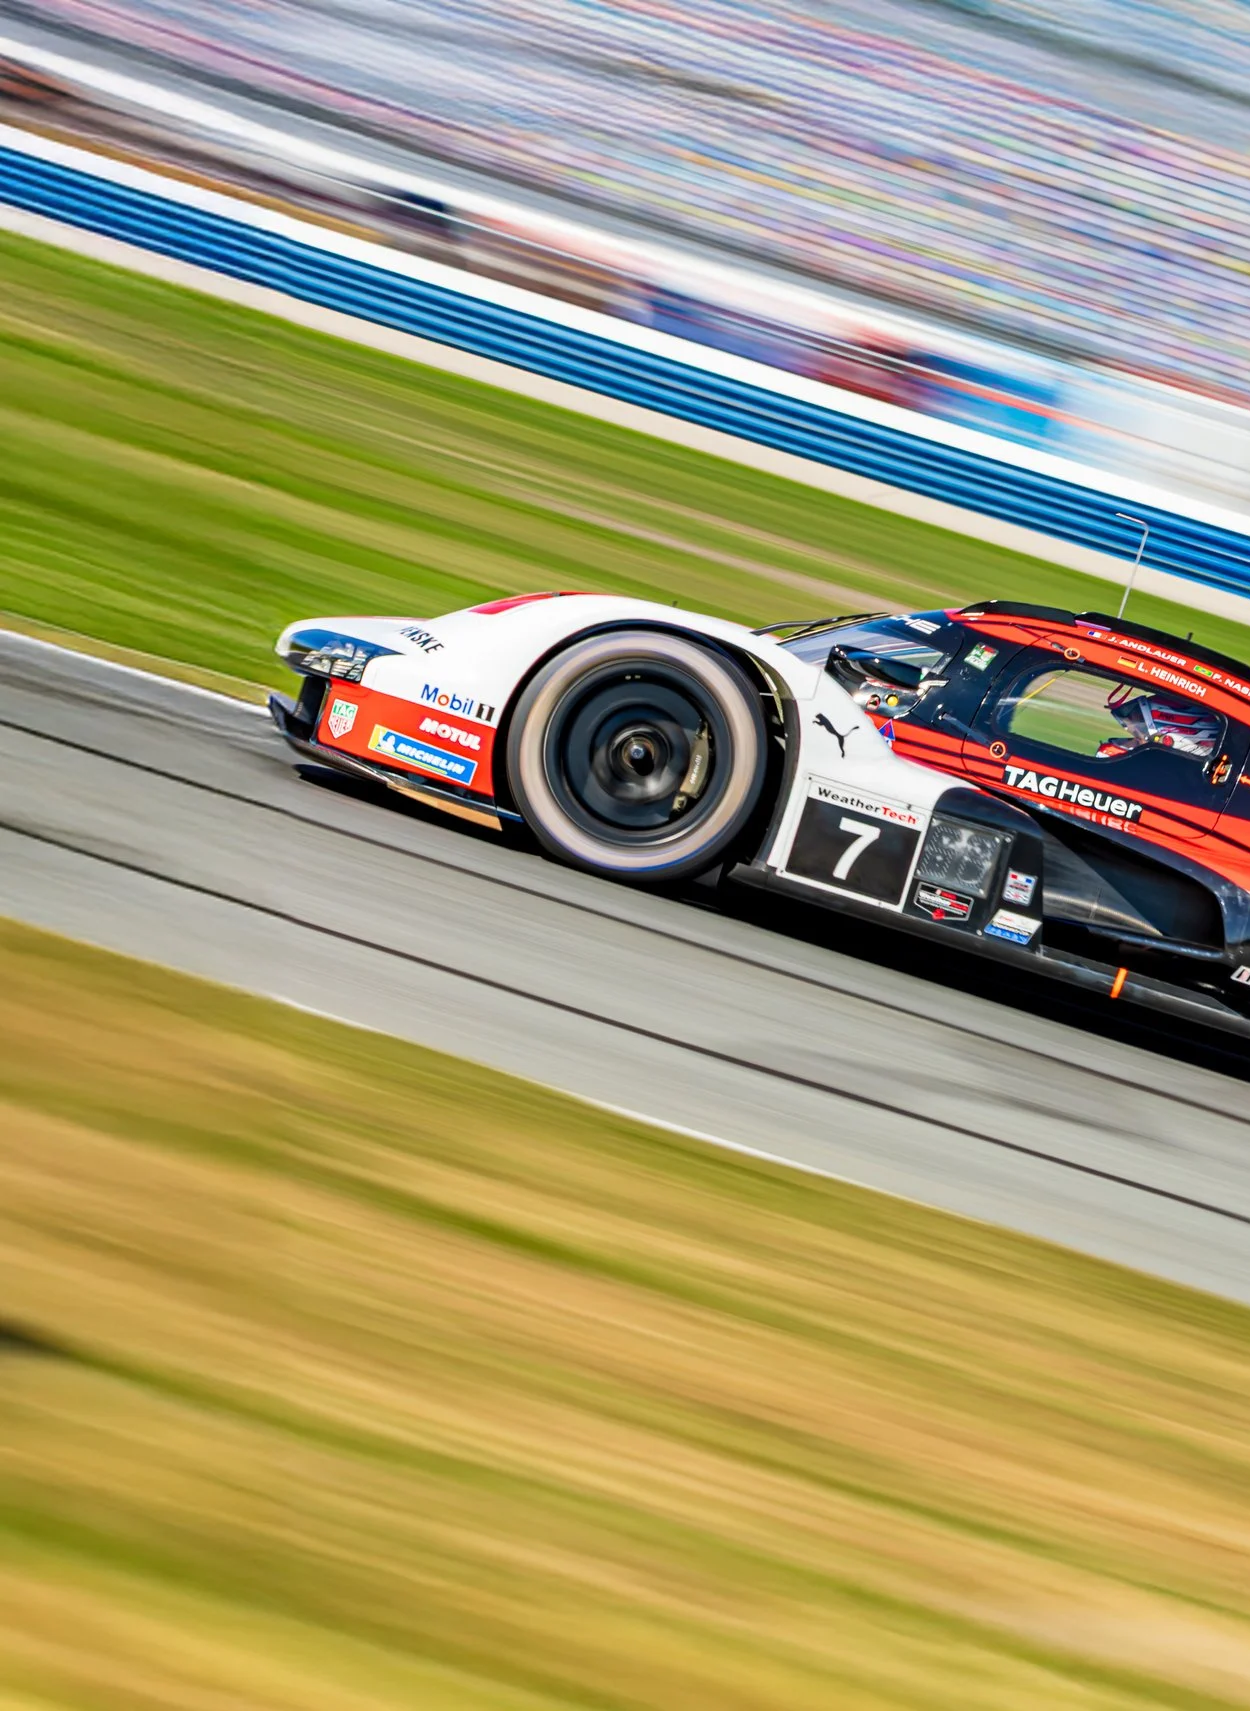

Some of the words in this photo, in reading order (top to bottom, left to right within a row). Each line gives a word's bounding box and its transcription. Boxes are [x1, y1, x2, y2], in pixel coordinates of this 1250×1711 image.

[1119, 639, 1187, 667] ANDLAUER
[1138, 662, 1149, 676] L.
[1150, 667, 1207, 698] HEINRICH
[1212, 672, 1222, 684] F.
[333, 701, 356, 719] TAG
[420, 683, 474, 715] Mobil
[476, 703, 495, 722] 1
[418, 717, 482, 751] MOTUL
[396, 743, 466, 776] MICHELIN
[817, 786, 918, 825] WeatherTech
[832, 817, 881, 881] 7
